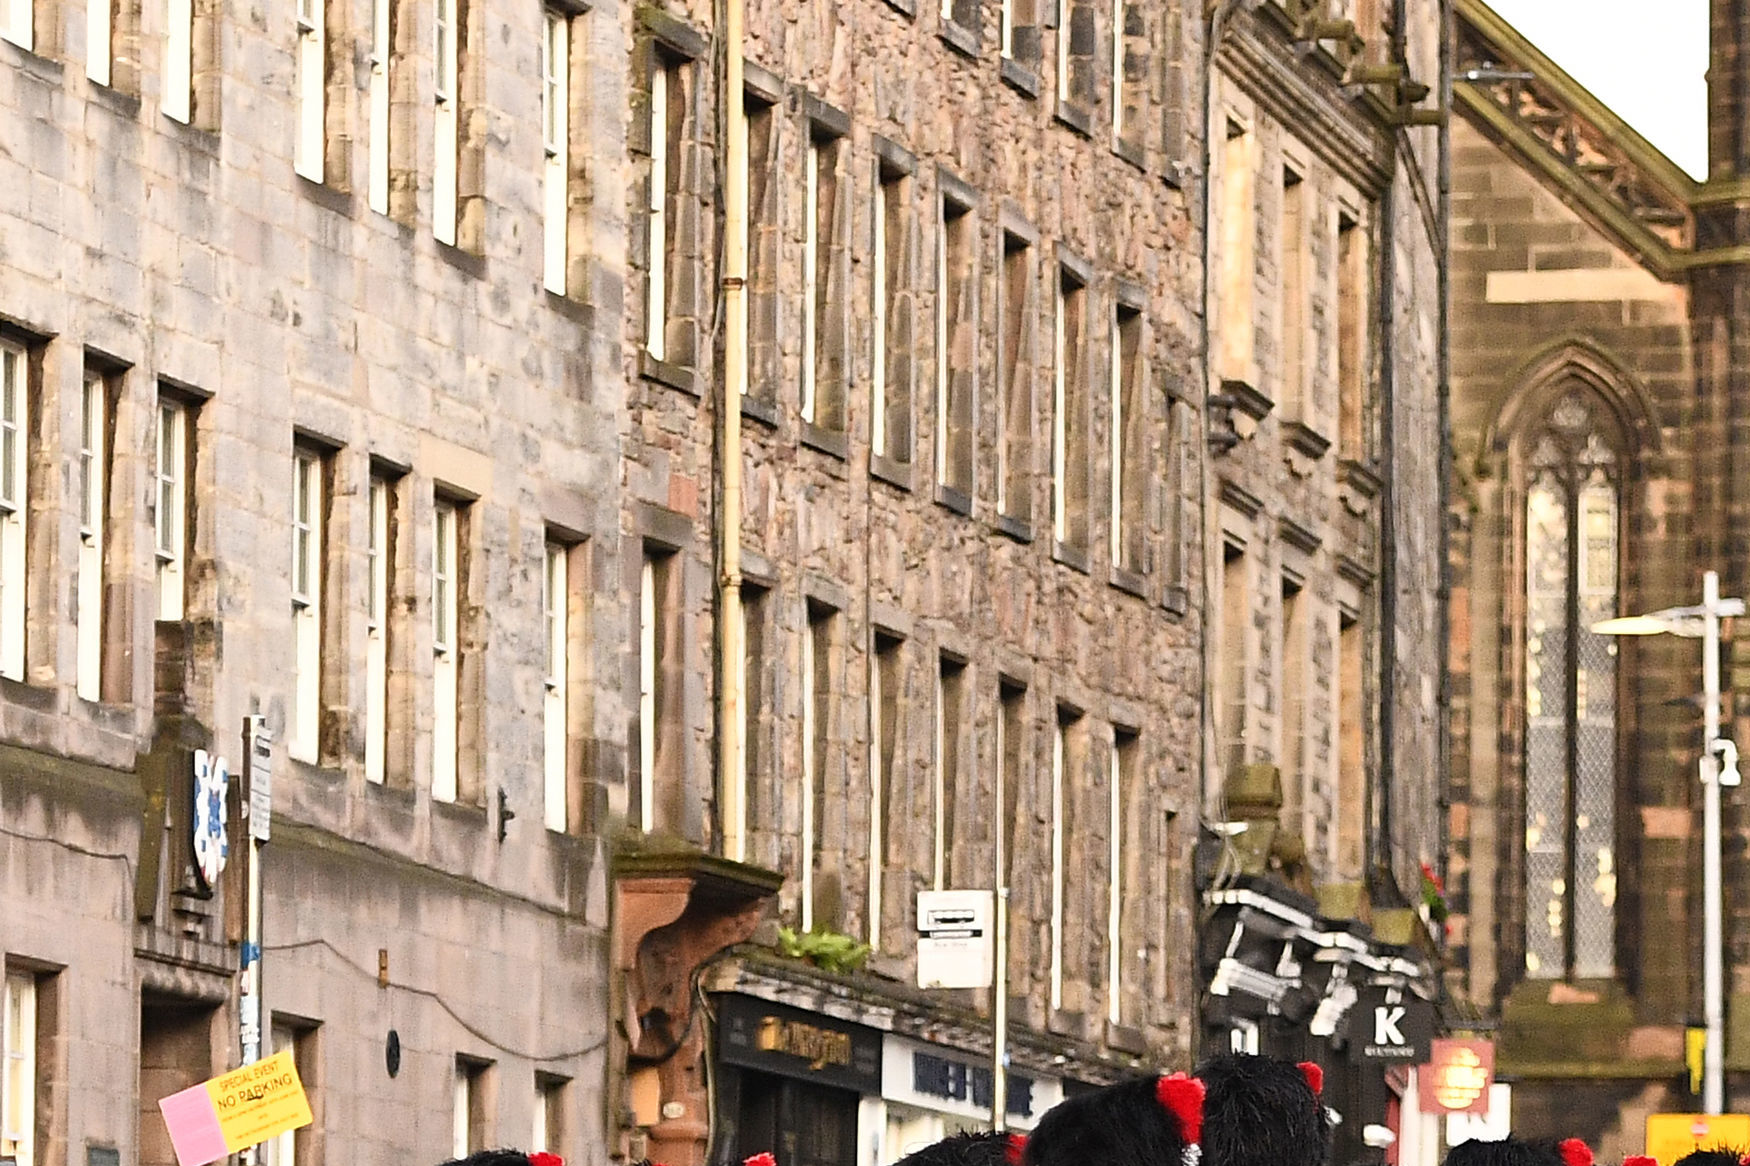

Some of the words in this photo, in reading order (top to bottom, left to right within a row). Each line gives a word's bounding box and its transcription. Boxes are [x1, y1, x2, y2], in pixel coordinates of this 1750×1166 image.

[1374, 1006, 1406, 1045] K
[217, 1095, 236, 1111] NO
[239, 1073, 293, 1101] PARKING
[219, 1075, 253, 1093] SPECIAL
[254, 1060, 280, 1079] EVENT
